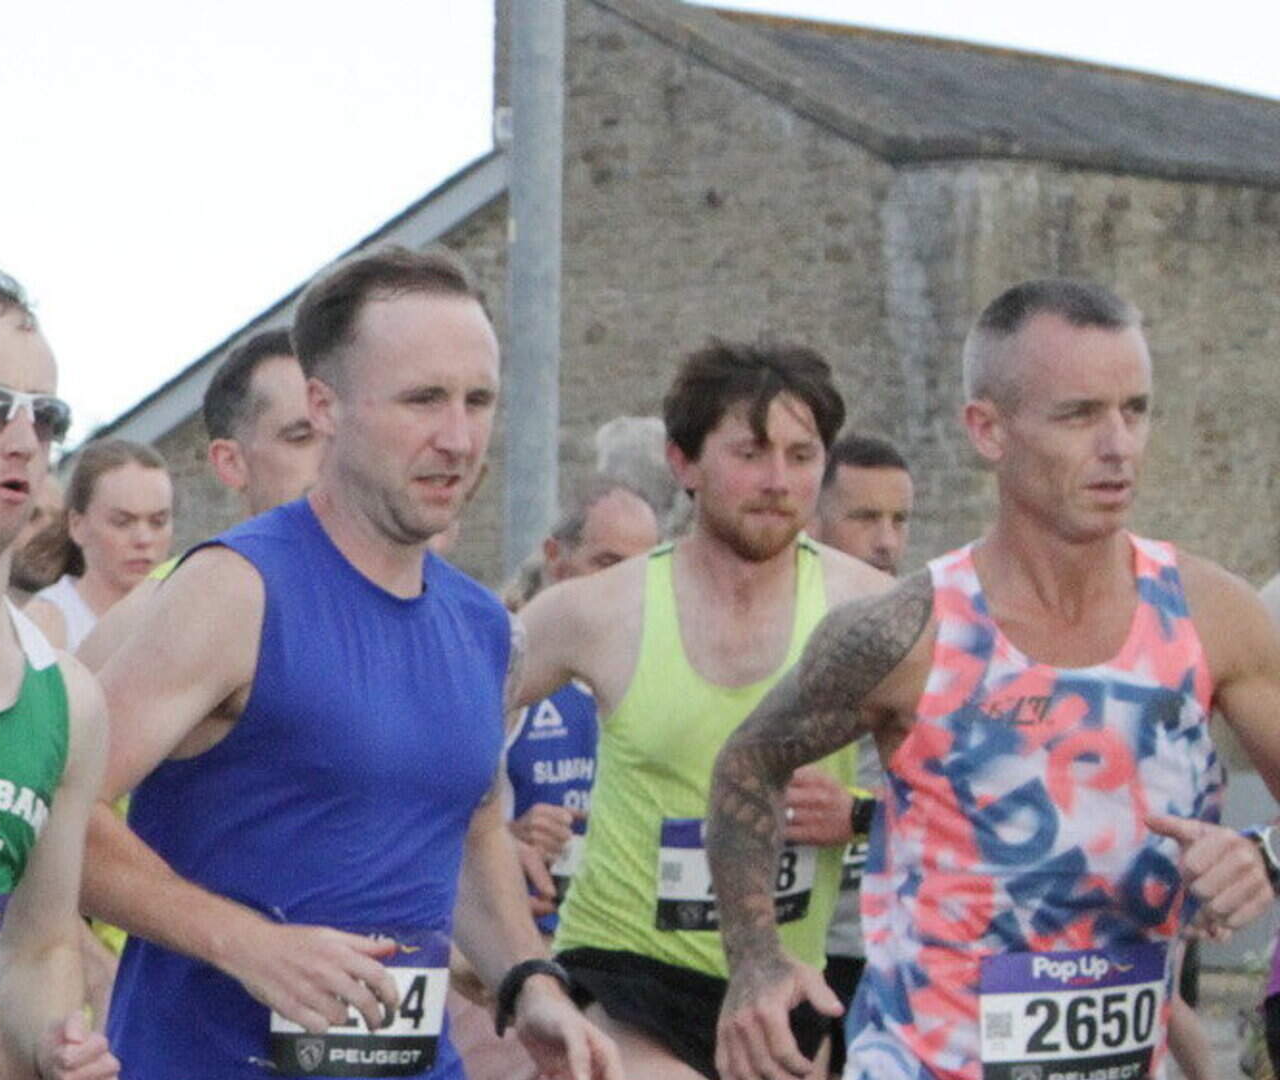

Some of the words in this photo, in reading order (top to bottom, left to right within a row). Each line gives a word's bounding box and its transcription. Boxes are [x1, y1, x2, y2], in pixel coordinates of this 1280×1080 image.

[1031, 955, 1078, 985] Pop
[1079, 955, 1110, 981] Up
[1024, 987, 1157, 1055] 2650
[328, 1048, 423, 1066] PEUGEOT
